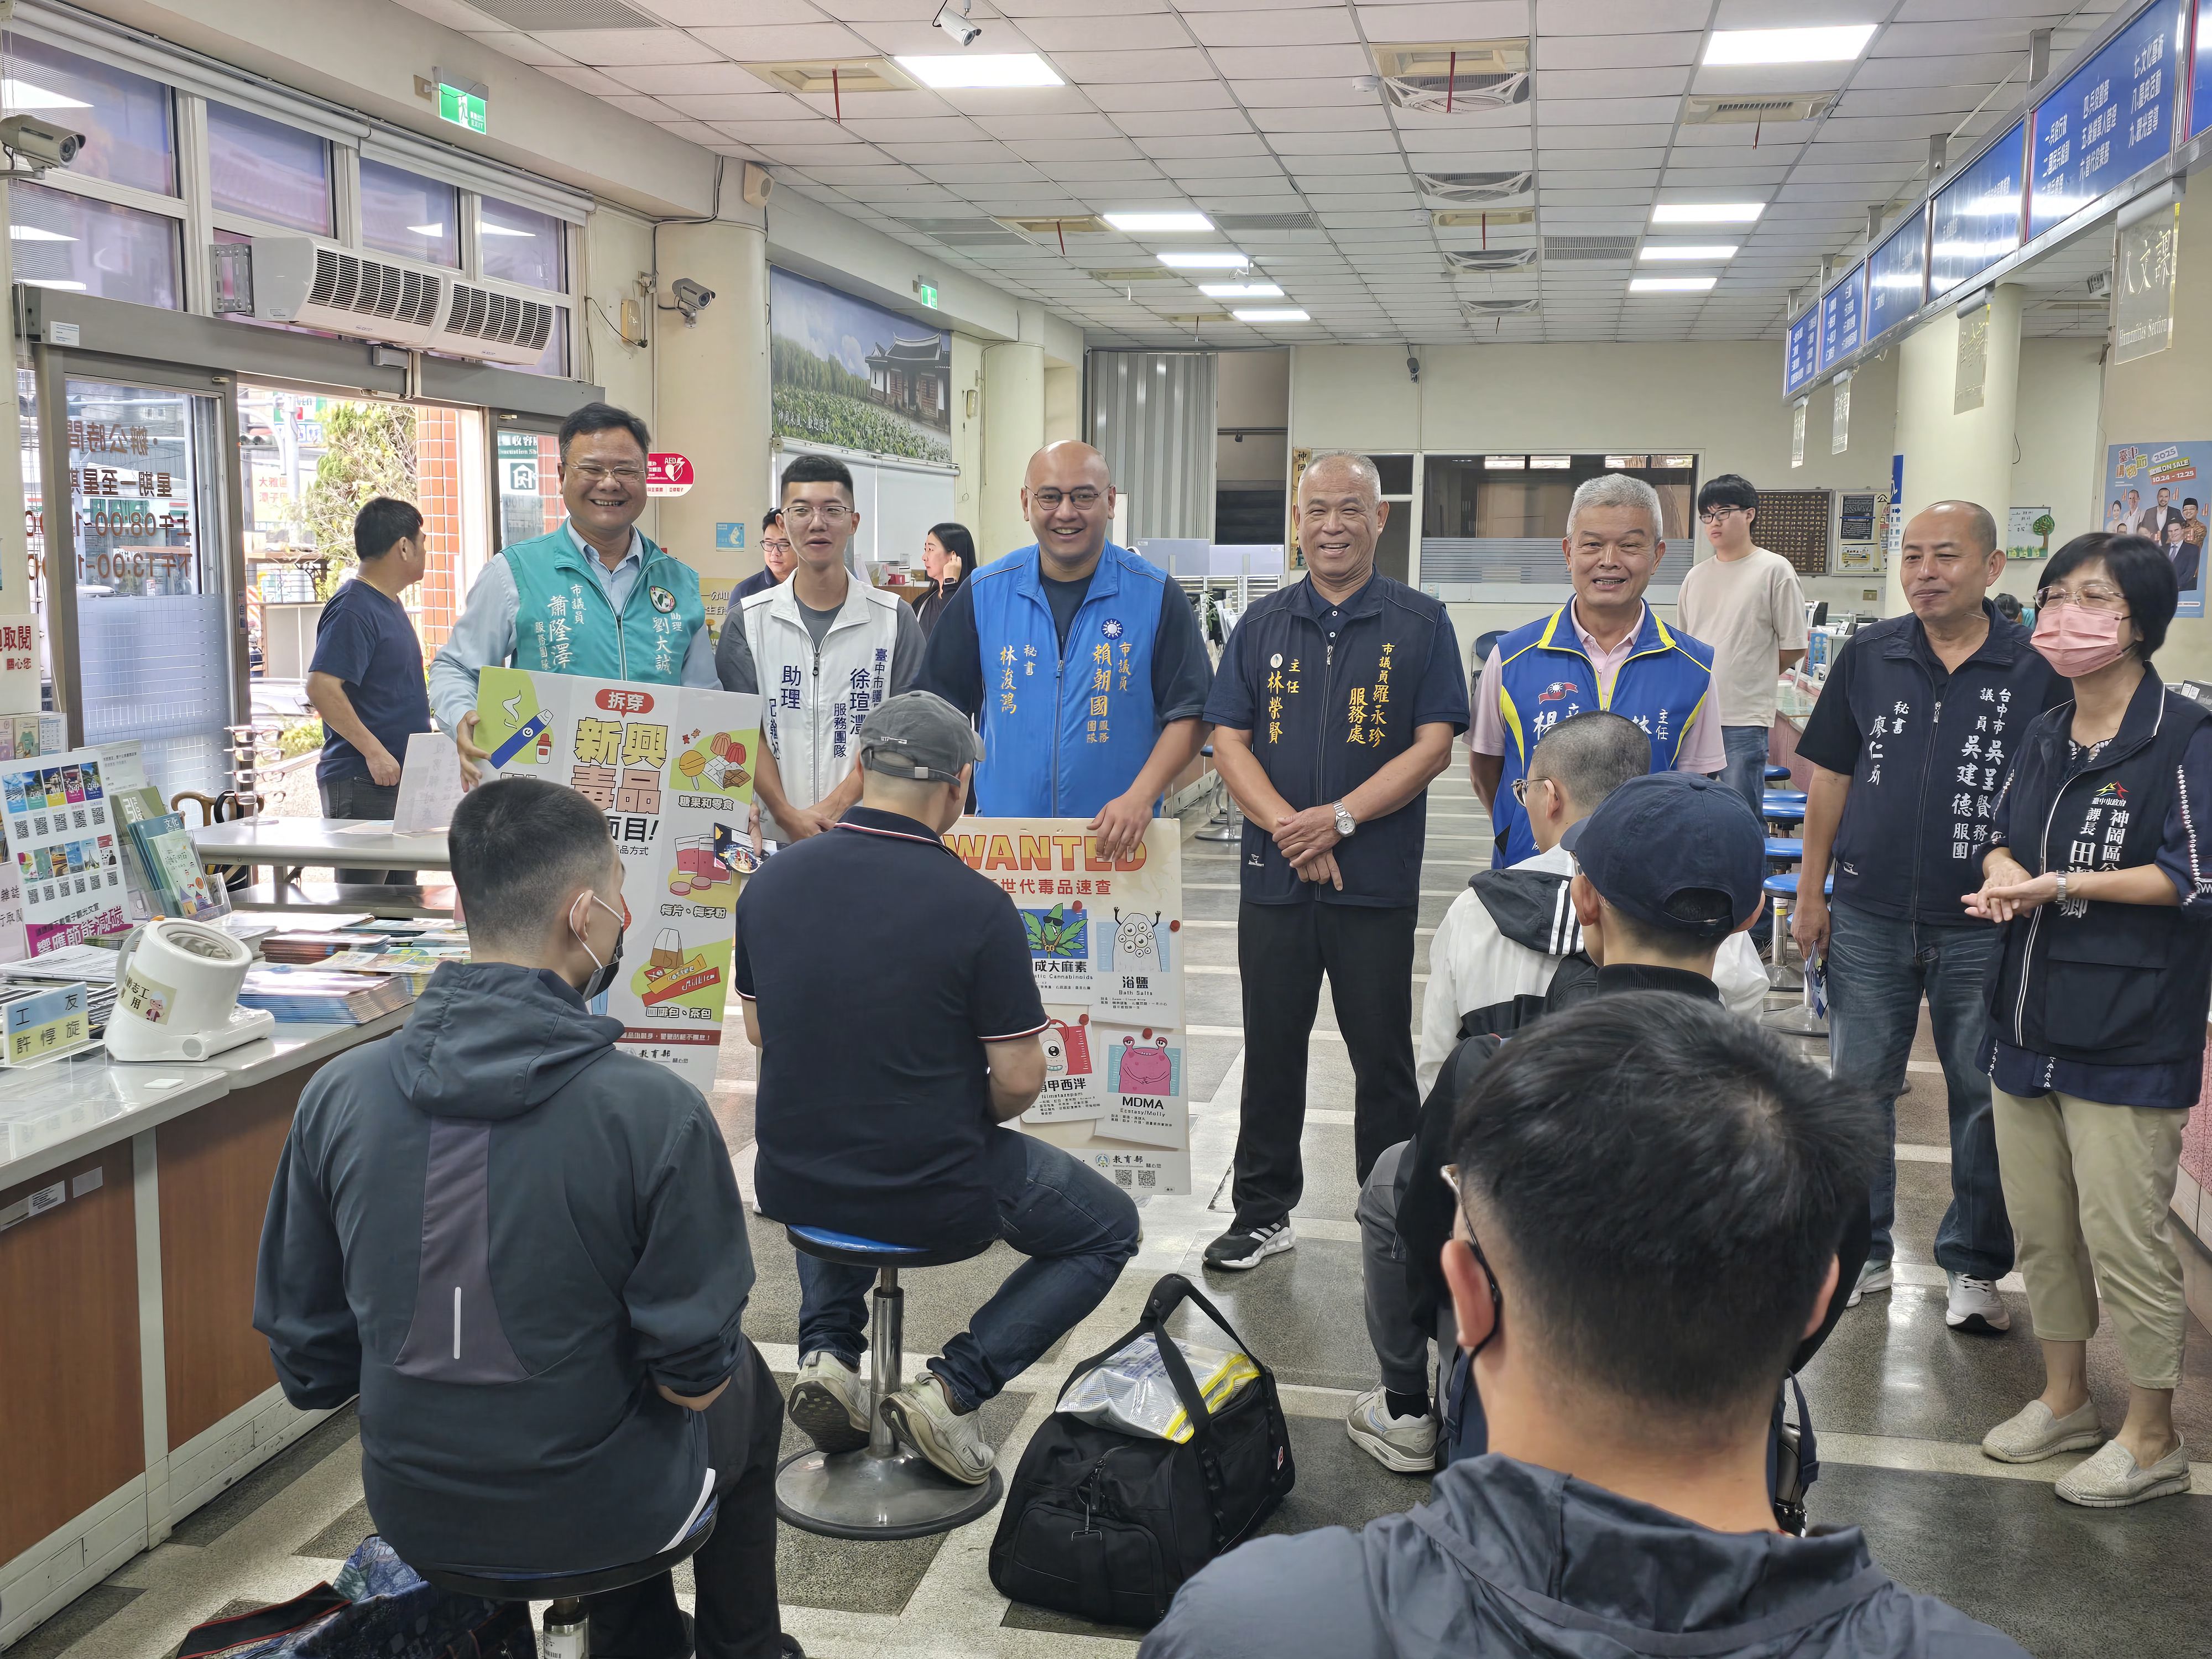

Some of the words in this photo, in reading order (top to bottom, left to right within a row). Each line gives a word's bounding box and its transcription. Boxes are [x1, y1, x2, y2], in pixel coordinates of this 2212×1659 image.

[2154, 448, 2176, 462] 2025
[571, 584, 586, 624] 市議員
[547, 594, 573, 669] 蕭隆澤
[670, 613, 683, 632] 助理
[652, 617, 672, 675] 劉大誠
[1024, 644, 1037, 676] 秘書
[872, 648, 888, 708] 臺中市議
[1091, 643, 1113, 717] 賴朝國
[1118, 641, 1132, 691] 市議員
[1286, 659, 1301, 693] 主任
[608, 692, 644, 711] 拆穿
[781, 665, 801, 709] 助理
[1267, 670, 1284, 744] 林榮賢
[1346, 687, 1368, 744] 服務處
[1892, 701, 1910, 734] 秘書
[834, 703, 847, 758] 服務團隊
[1655, 709, 1669, 740] 主任
[573, 717, 668, 769] 新興
[571, 764, 661, 815] 毒品
[1952, 735, 1982, 817] 吳建德
[679, 795, 734, 811] 糖果和零食
[2080, 807, 2102, 836] 課長
[942, 834, 1147, 872] WANTED
[992, 879, 1111, 895] 世代毒品速查
[1122, 976, 1149, 989] 浴鹽
[17, 1020, 80, 1055] 許惇旋
[639, 1050, 670, 1058] 教育部
[1120, 1108, 1166, 1117] Ecstasy/Molly
[1122, 1096, 1164, 1110] MDMA
[1113, 1155, 1143, 1164] 教育部
